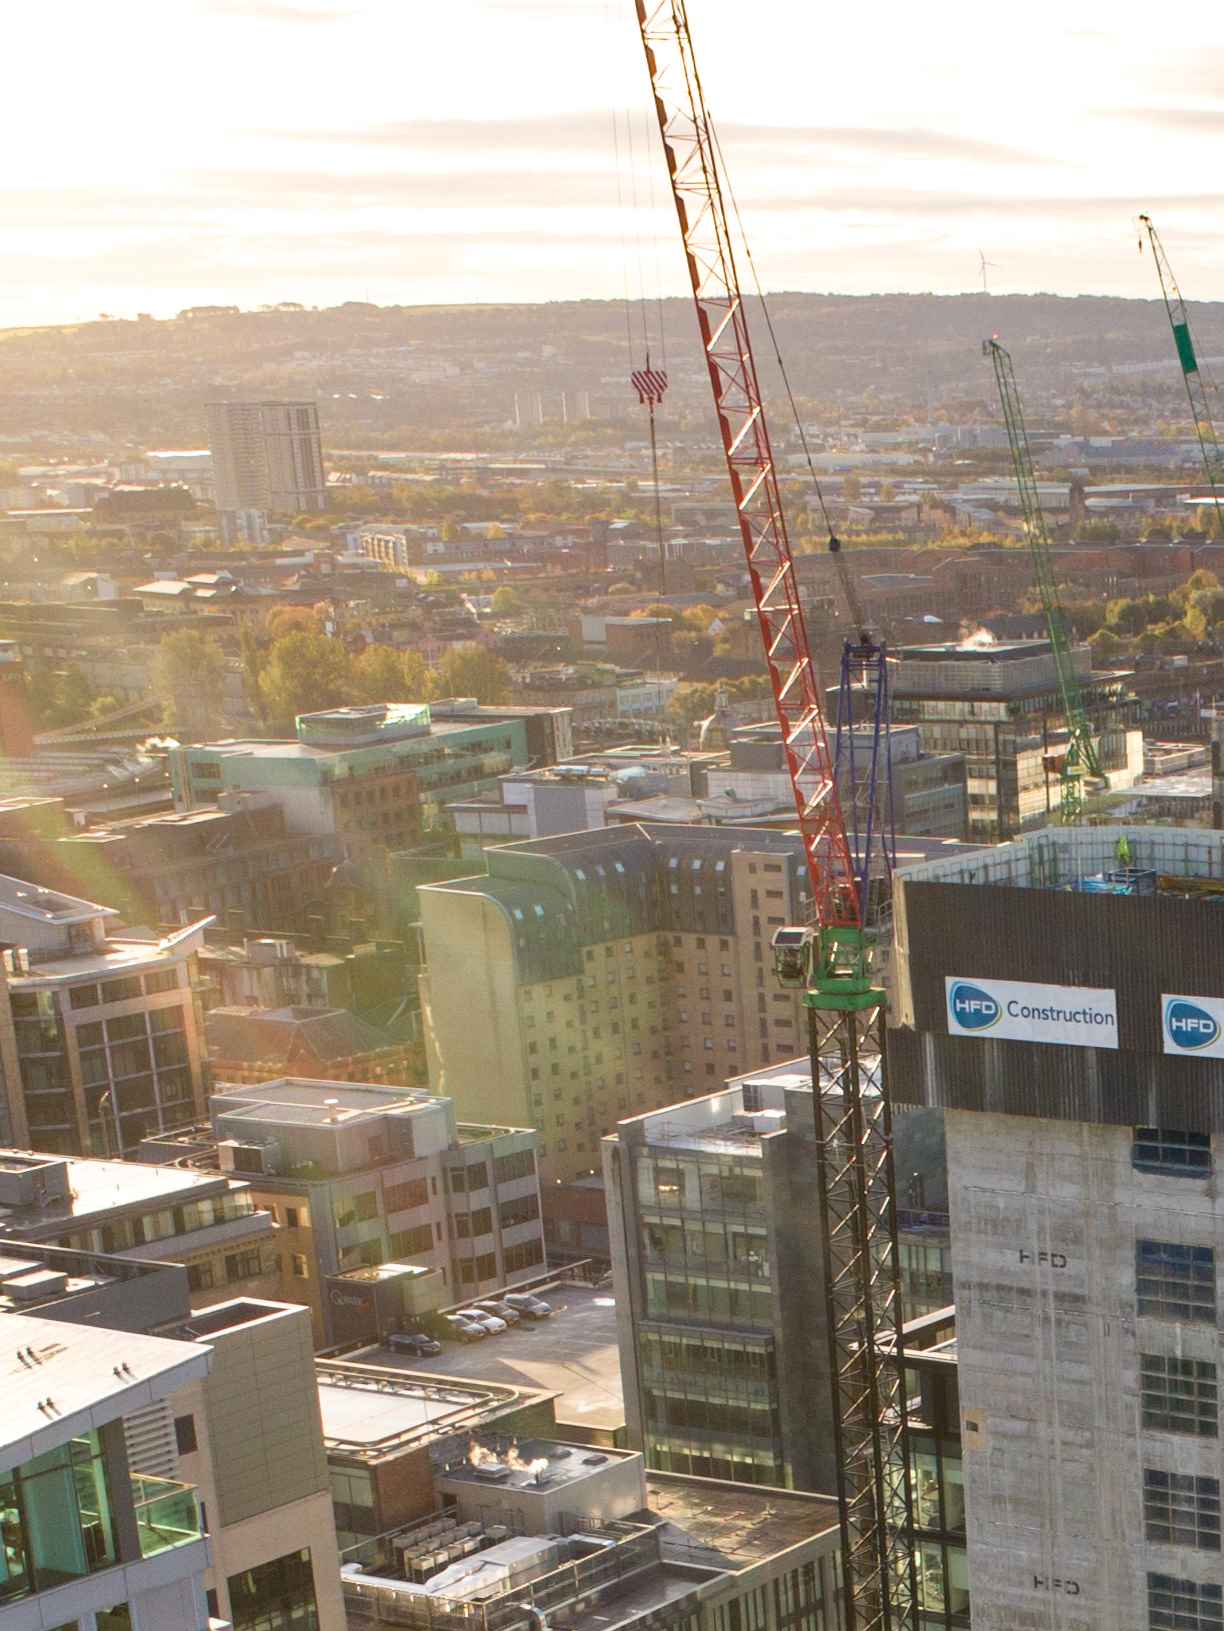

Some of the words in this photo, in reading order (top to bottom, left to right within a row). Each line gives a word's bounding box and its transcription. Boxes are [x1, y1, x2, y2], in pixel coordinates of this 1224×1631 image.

[955, 999, 996, 1014] HFD
[1007, 1001, 1115, 1026] Construction
[1171, 1016, 1215, 1032] HFD
